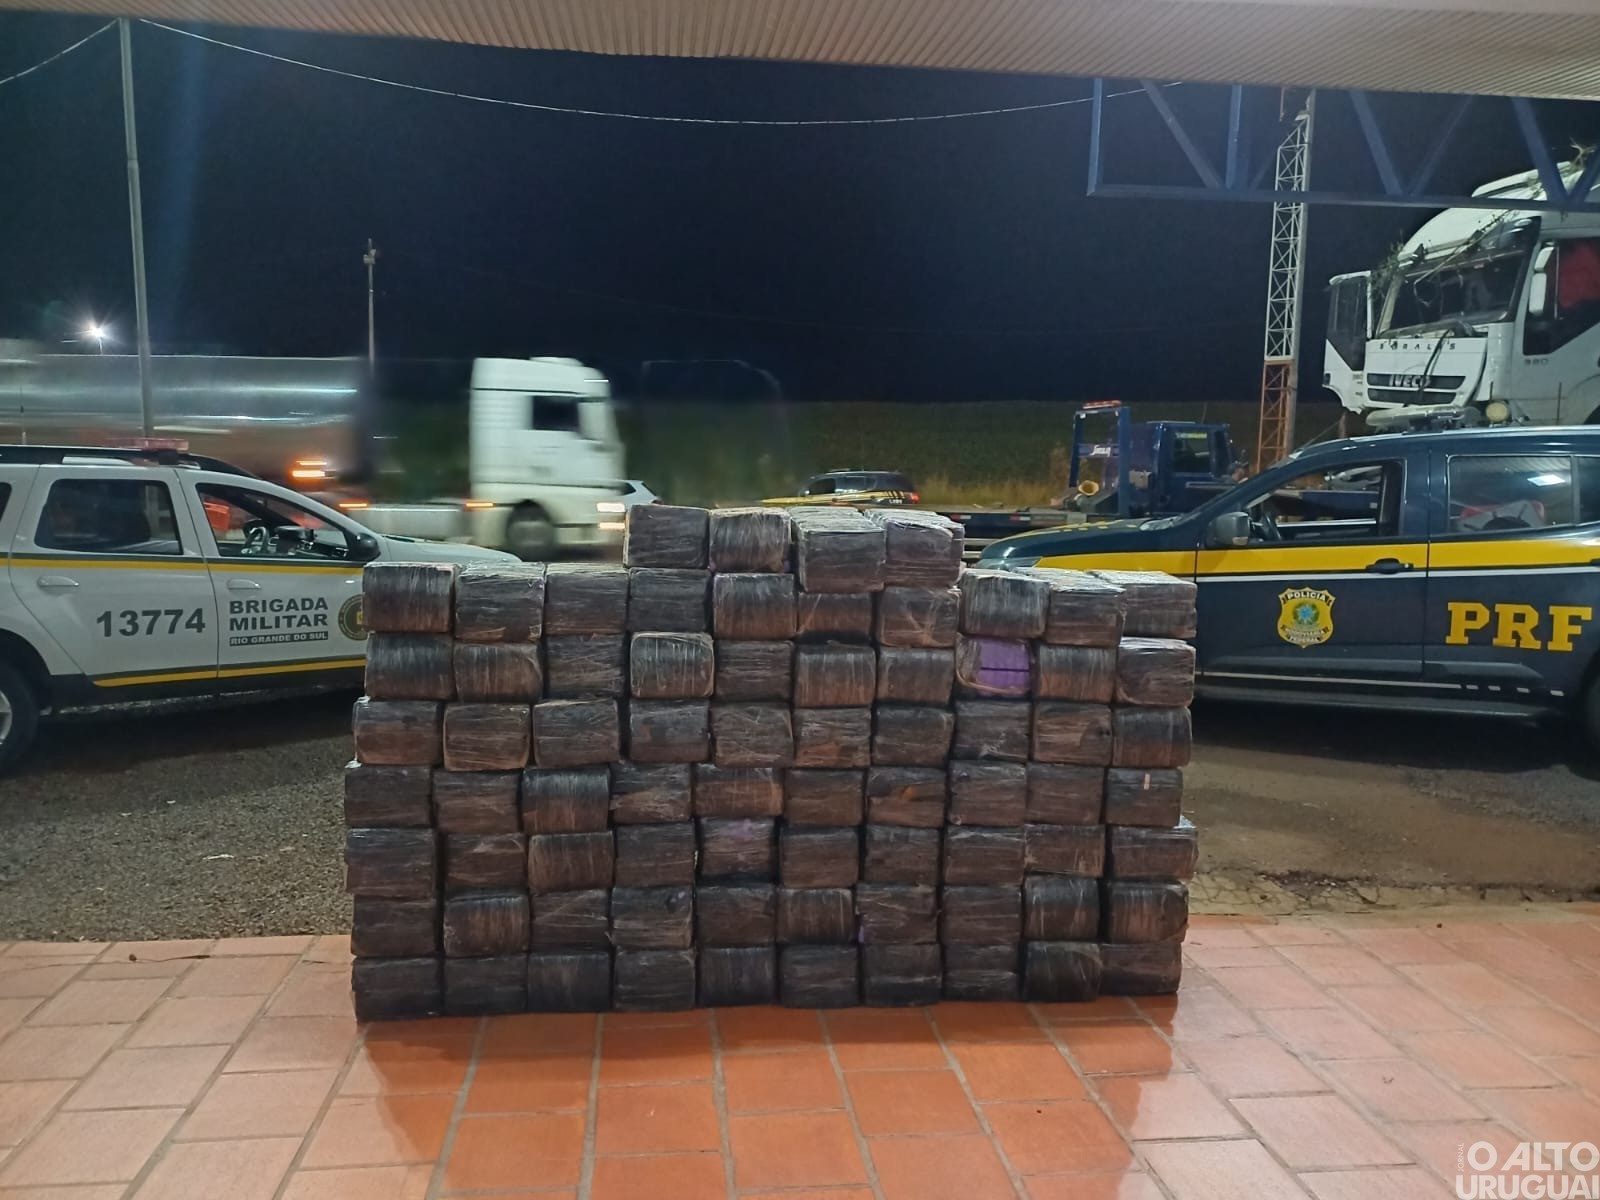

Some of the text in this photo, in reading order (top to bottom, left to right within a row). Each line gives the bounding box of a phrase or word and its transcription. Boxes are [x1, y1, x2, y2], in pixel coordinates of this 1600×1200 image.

[229, 597, 328, 614] BRIGADA
[96, 608, 206, 637] 13774
[229, 613, 328, 631] MILITAR
[1445, 601, 1592, 652] PRF
[230, 631, 327, 645] RIO GRANDE DO SUL
